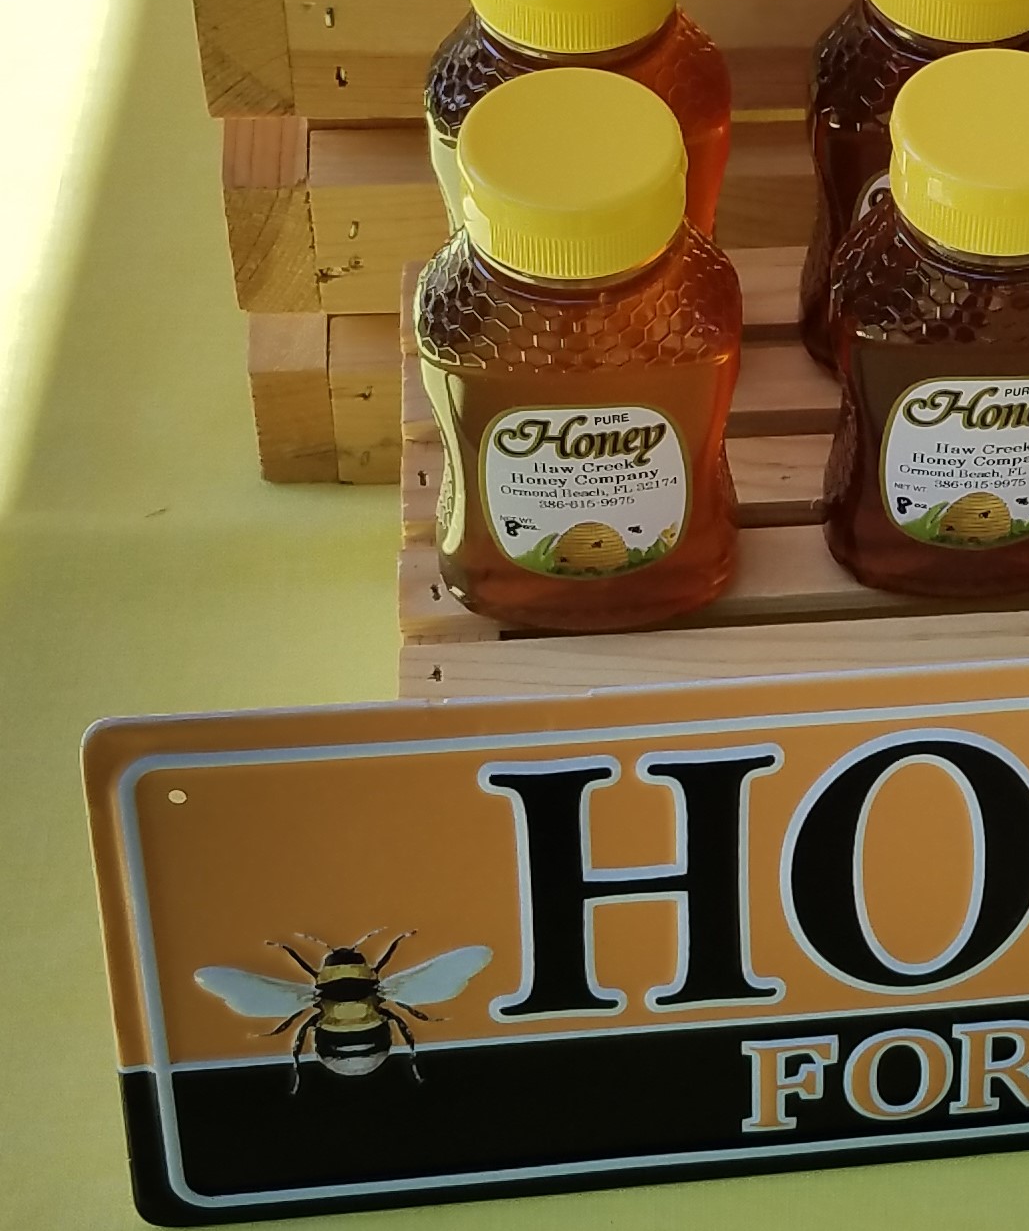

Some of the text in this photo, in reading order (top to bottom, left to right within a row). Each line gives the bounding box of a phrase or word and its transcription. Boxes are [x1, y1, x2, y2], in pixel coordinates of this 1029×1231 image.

[594, 413, 630, 425] PURE
[494, 415, 667, 466] Honey
[936, 443, 975, 454] Haw
[534, 459, 633, 474] Haw Creek
[912, 453, 967, 469] Honey
[510, 468, 659, 488] Honey Company
[899, 465, 954, 478] Ormond
[959, 469, 1003, 479] Beach,
[1008, 468, 1027, 477] FL
[934, 479, 1027, 489] 386-615-9975
[500, 485, 557, 498] Ormond
[562, 488, 609, 498] Beach,
[613, 486, 633, 495] FL
